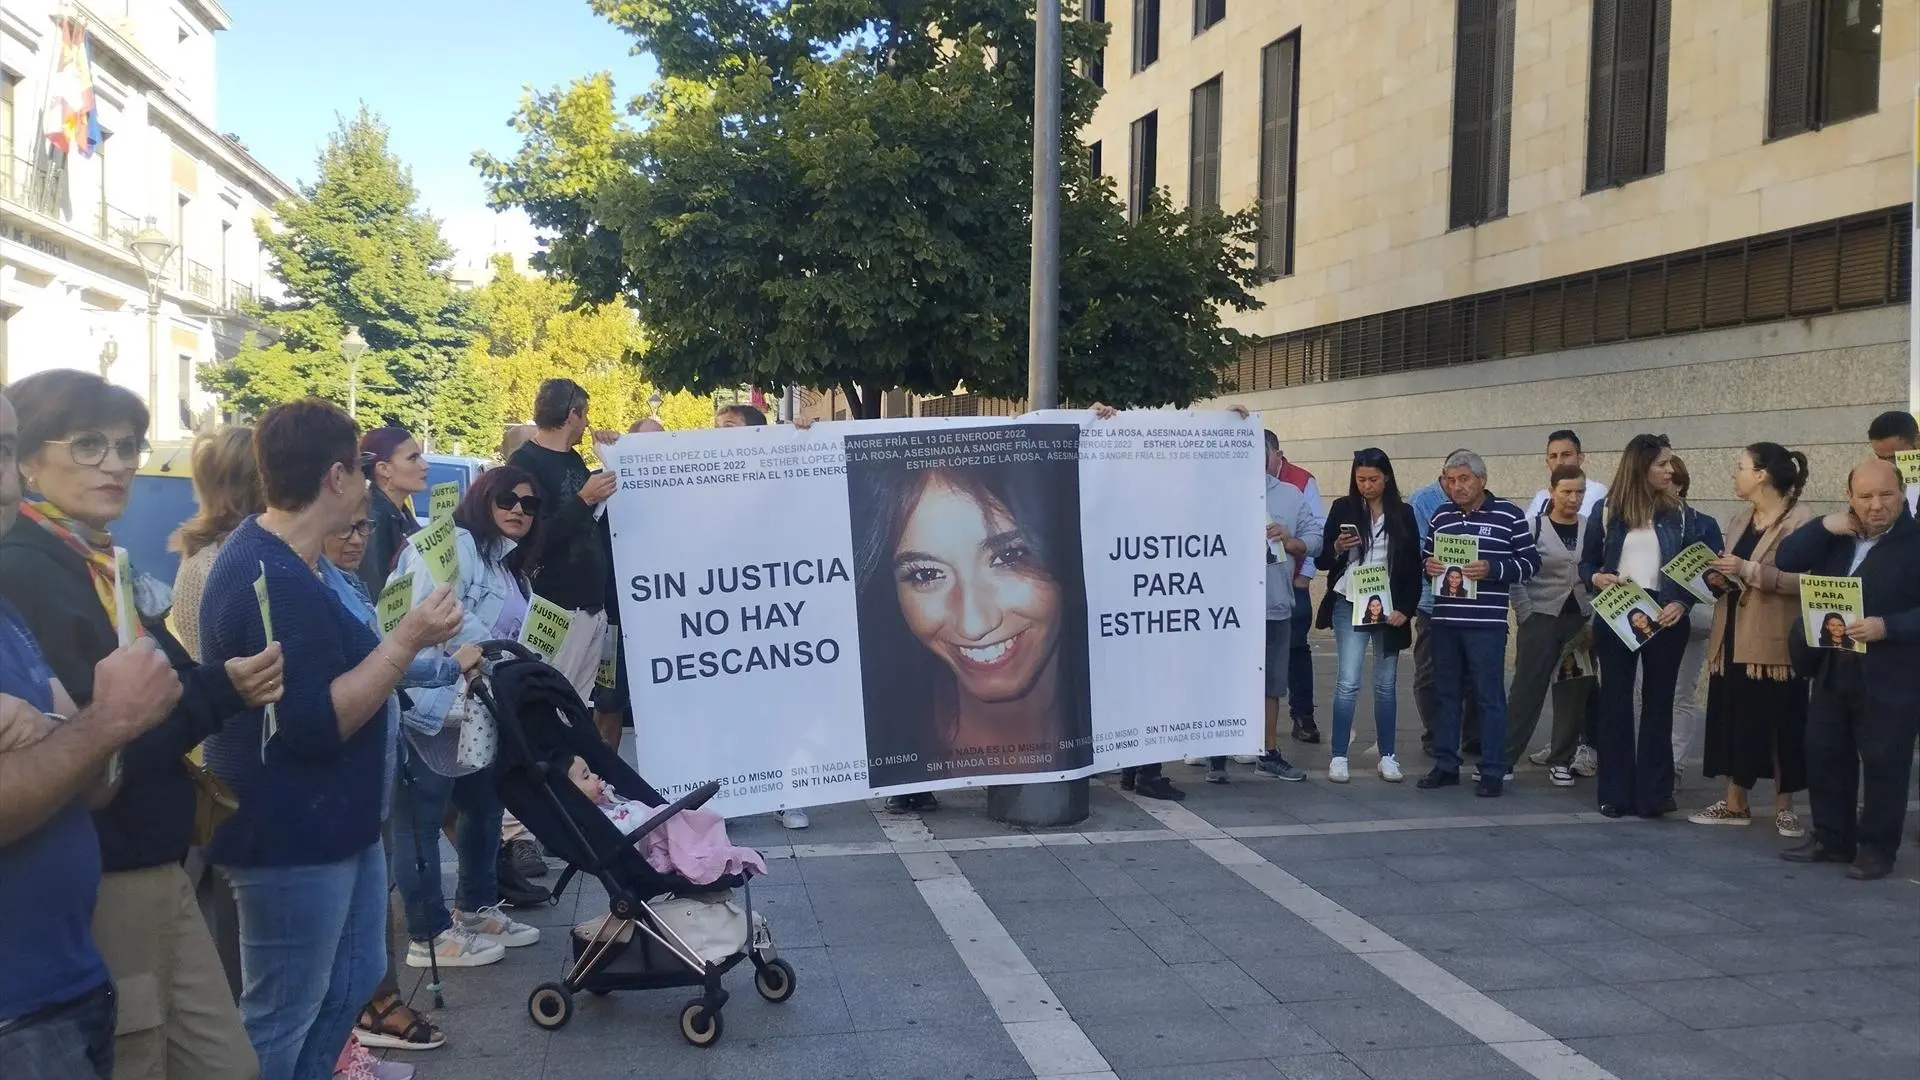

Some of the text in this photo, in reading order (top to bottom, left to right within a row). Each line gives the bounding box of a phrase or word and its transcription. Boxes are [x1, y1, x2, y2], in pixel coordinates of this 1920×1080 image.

[1092, 429, 1103, 437] DE
[1106, 429, 1116, 437] LA
[1147, 429, 1193, 437] ASESINADA
[1195, 429, 1200, 437] A
[1202, 429, 1234, 437] SANGRE
[1237, 428, 1254, 437] FRÍA
[620, 453, 662, 464] ESTHER
[666, 450, 701, 462] LÓPEZ
[704, 450, 717, 459] DE
[721, 449, 733, 457] LA
[771, 442, 829, 455] ASESINADA
[831, 441, 838, 450] A
[840, 438, 882, 451] SANGRE
[885, 436, 908, 447] FRÍA
[911, 436, 923, 445] EL
[926, 435, 937, 444] 13
[940, 435, 952, 443] DE
[955, 432, 1002, 442] ENERODE
[1005, 430, 1026, 439] 2022
[760, 457, 798, 467] ESTHER
[838, 453, 852, 462] DE
[855, 452, 868, 461] LA
[904, 447, 961, 458] ASESINADA
[963, 446, 971, 454] A
[973, 442, 1012, 453] SANGRE
[1015, 439, 1037, 450] FRÍA
[1039, 441, 1050, 449] EL
[1052, 440, 1061, 448] 13
[1207, 440, 1217, 448] DE
[1219, 440, 1230, 448] LA
[621, 461, 745, 477] EL 13 DE ENERODE 2022
[907, 459, 946, 470] ESTHER
[949, 455, 980, 467] LÓPEZ
[983, 456, 996, 465] DE
[999, 455, 1011, 464] LA
[1232, 451, 1249, 459] 2022
[621, 477, 684, 490] ASESINADA
[687, 477, 694, 486] A
[696, 474, 740, 485] SANGRE
[743, 471, 766, 482] FRÍA
[769, 471, 781, 479] EL
[784, 470, 793, 478] 13
[796, 468, 809, 477] DE
[436, 500, 455, 509] PARA
[1109, 534, 1227, 561] JUSTICIA
[1444, 547, 1465, 555] PARA
[1439, 556, 1470, 564] ESTHER
[1681, 555, 1704, 573] PARA
[631, 558, 850, 602] SIN JUSTICIA
[1133, 572, 1204, 597] PARA
[1801, 579, 1859, 588] #JUSTICIA
[1359, 585, 1385, 594] ESTHER
[1593, 576, 1633, 609] #JUSTIA
[388, 598, 403, 613] PARA
[1608, 590, 1630, 609] PARA
[1609, 594, 1641, 621] ESTHER
[1809, 602, 1852, 611] ESTHER
[533, 603, 570, 630] #JUSTICIA
[680, 600, 806, 638] NO HAY
[1100, 606, 1240, 637] ESTHER YA
[537, 623, 556, 639] PARA
[527, 634, 555, 655] ESTHER
[651, 638, 840, 684] DESCANSO
[1146, 726, 1159, 735] SIN
[1170, 722, 1191, 732] NADA
[1193, 721, 1203, 729] ES
[1205, 720, 1216, 728] LO
[1217, 718, 1247, 727] MISMO
[1059, 740, 1074, 749] SIN
[1096, 733, 1104, 742] ES
[1105, 732, 1113, 740] LO
[1115, 728, 1138, 738] MISMO
[1144, 729, 1244, 746] SIN TI NADA ES LO MISMO
[955, 746, 984, 756] NADA
[986, 745, 1000, 753] ES
[1002, 745, 1016, 753] LO
[1096, 740, 1139, 754] ES LO MISMO
[792, 753, 918, 776] SIN TI NADA ES LO MISMO
[927, 754, 1052, 772] SIN TI NADA ES LO MISMO
[672, 785, 681, 794] TI
[716, 777, 729, 786] ES
[732, 775, 746, 784] LO
[749, 770, 783, 782] MISMO
[792, 772, 867, 789] SIN TI NADA ES
[717, 782, 784, 799] ES LO MISMO
